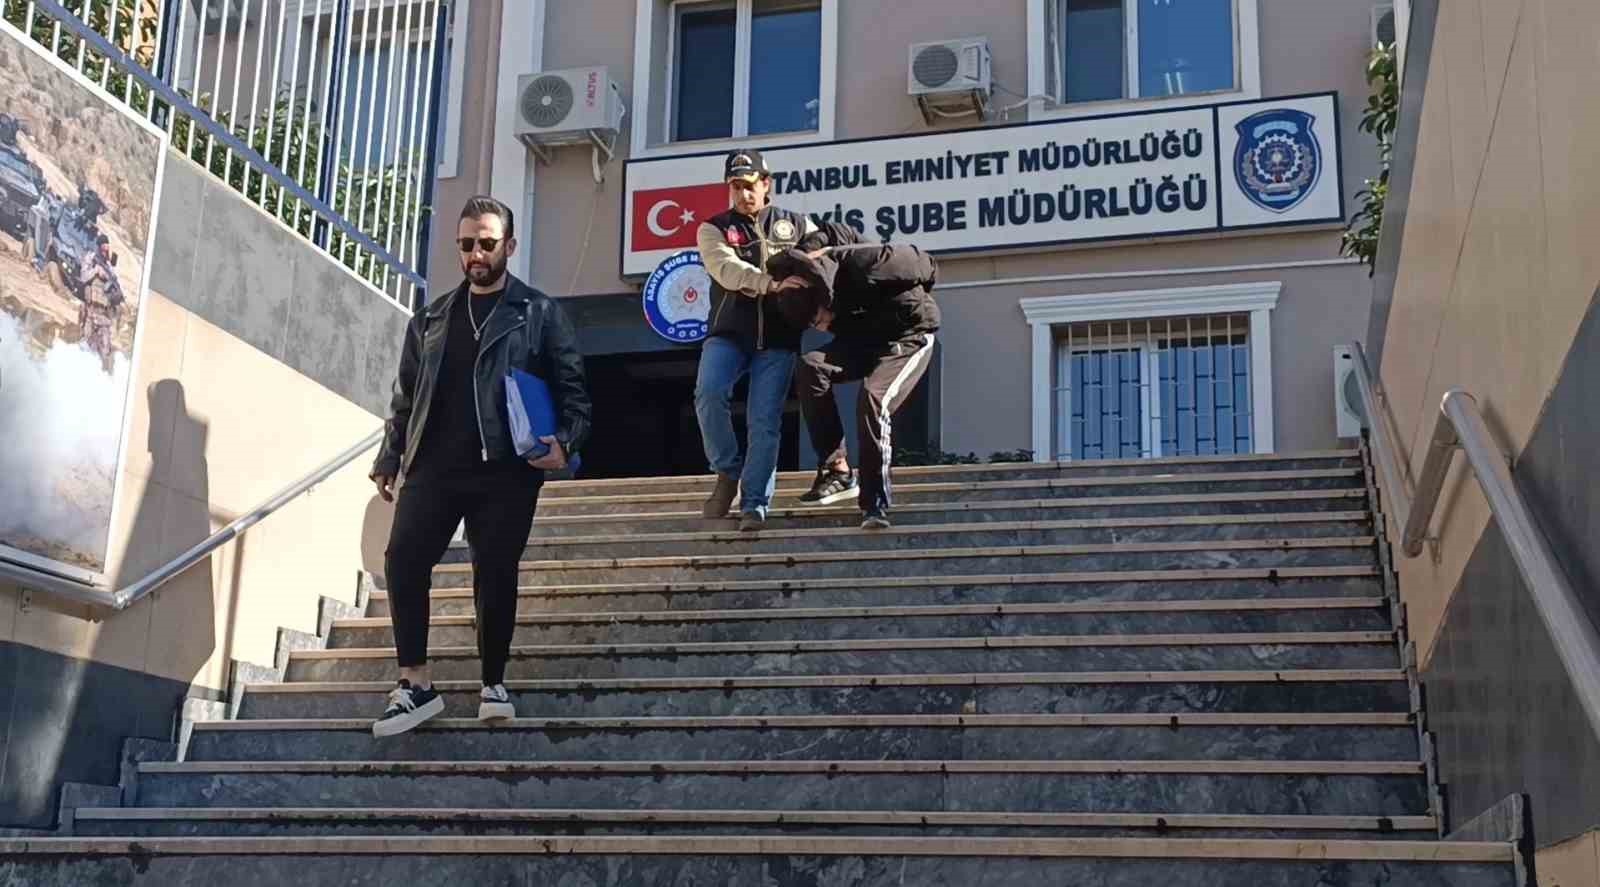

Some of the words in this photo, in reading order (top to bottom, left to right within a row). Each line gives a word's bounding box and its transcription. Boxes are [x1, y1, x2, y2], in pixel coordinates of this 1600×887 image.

[772, 164, 877, 194] TANBUL
[885, 150, 1009, 185] EMNİYET
[1018, 128, 1203, 173] MÜDÜRLÜĞÜ
[874, 200, 967, 243] ŞUBE
[978, 173, 1208, 229] MÜDÜRLÜĞÜ
